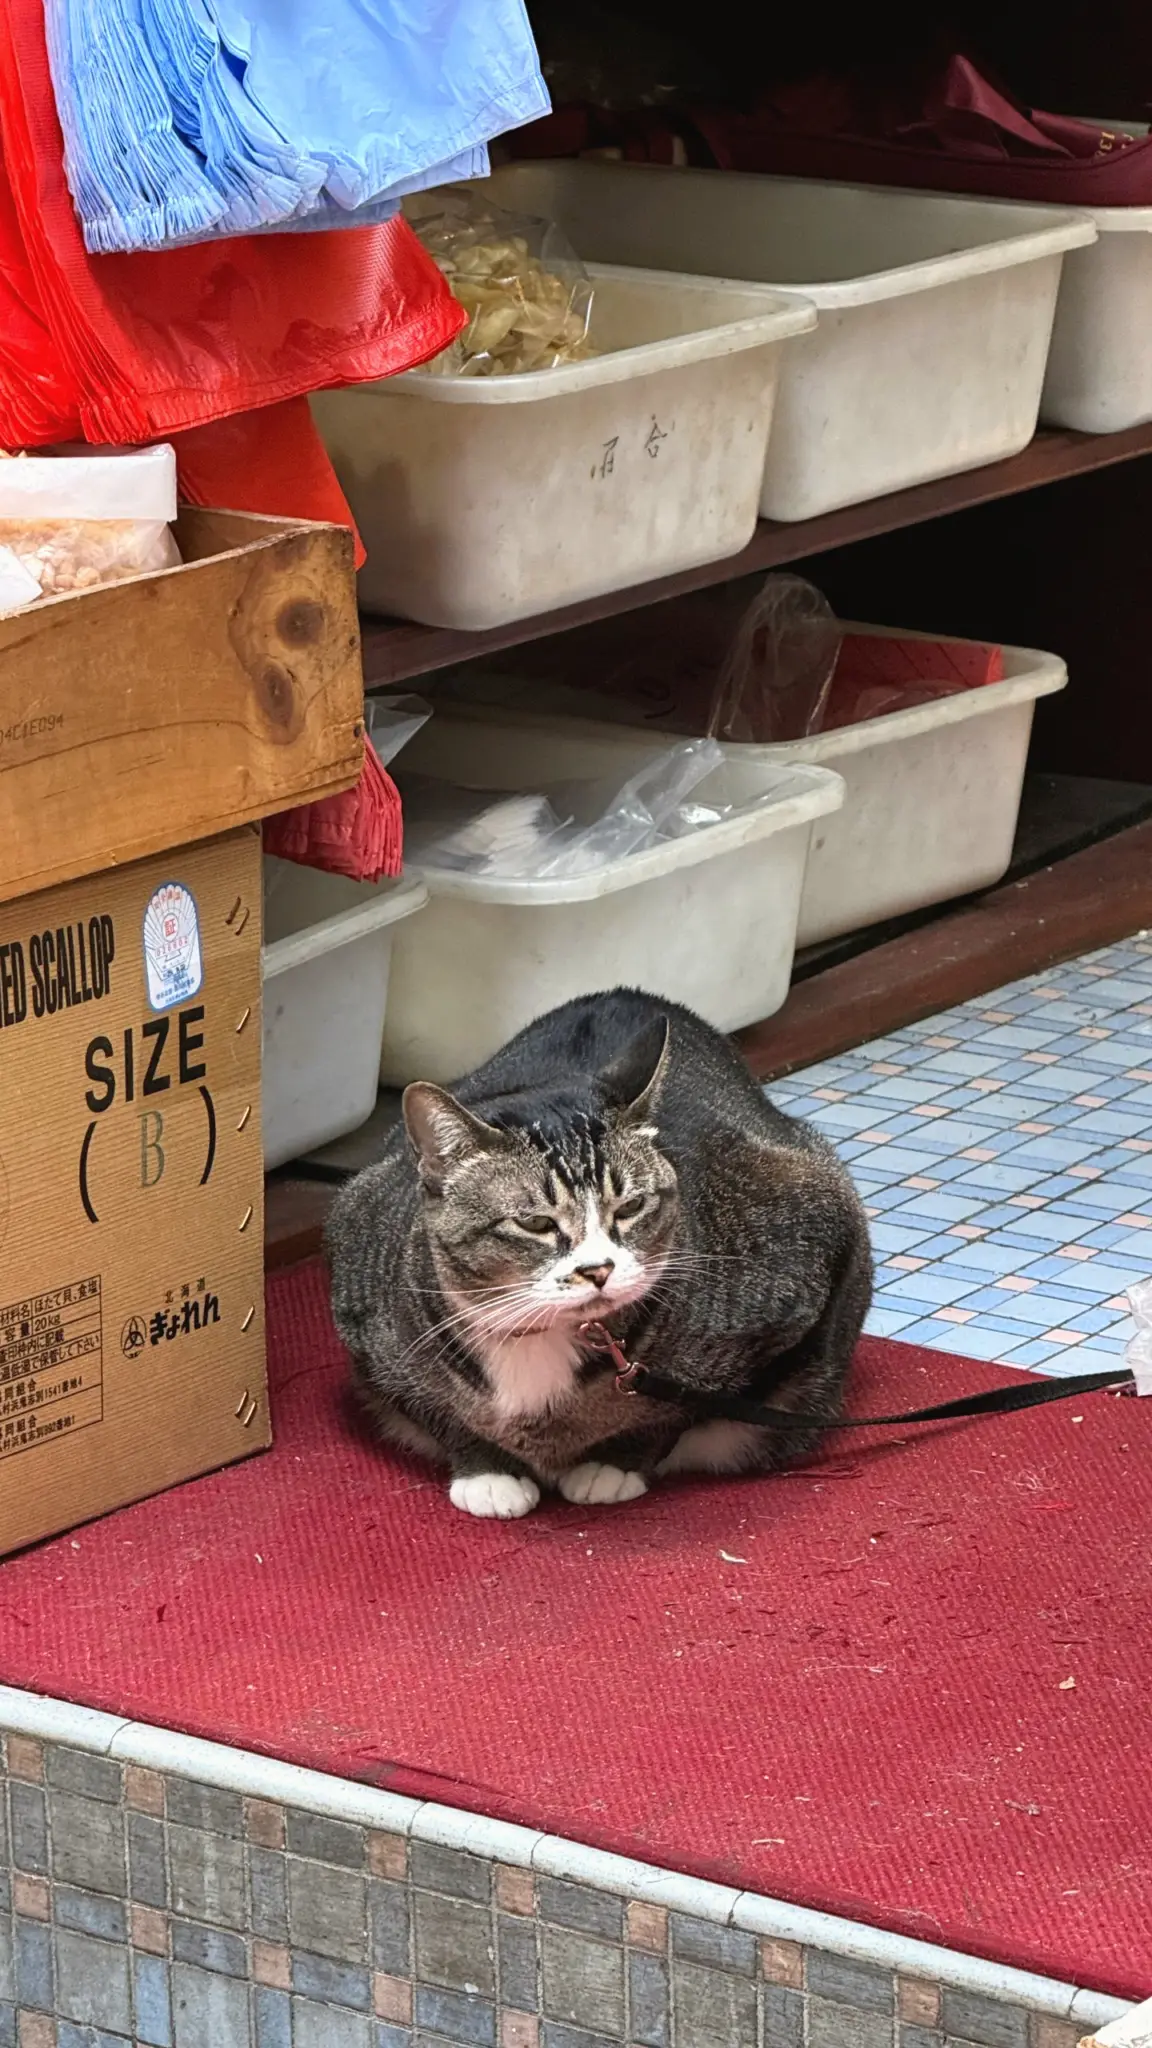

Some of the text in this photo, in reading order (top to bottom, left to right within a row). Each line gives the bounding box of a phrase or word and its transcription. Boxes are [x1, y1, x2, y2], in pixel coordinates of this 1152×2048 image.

[0, 914, 115, 1029] ED SCALLOP
[85, 1005, 206, 1113] SIZE
[164, 1276, 206, 1304] 北海道
[34, 1314, 61, 1333] 20kg
[149, 1292, 221, 1346] ぎょれん
[0, 1378, 37, 1404] 同組合
[0, 1414, 37, 1439] 同組合
